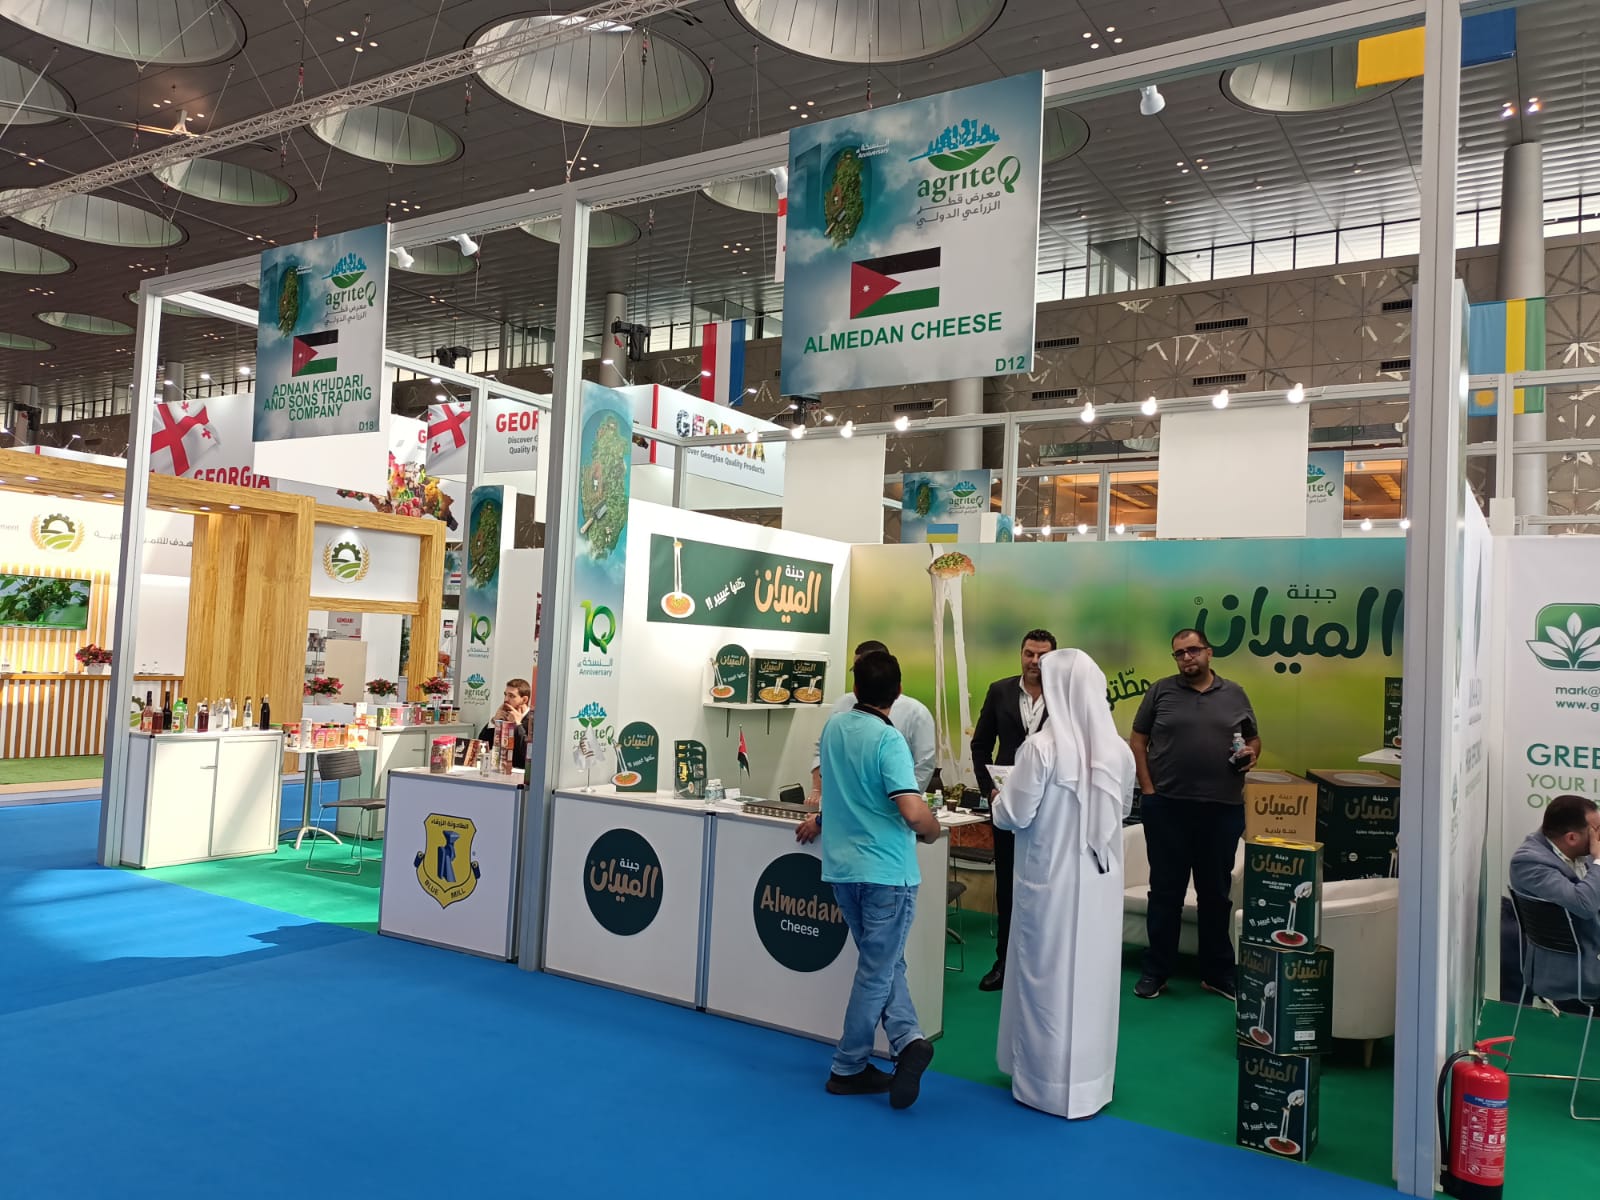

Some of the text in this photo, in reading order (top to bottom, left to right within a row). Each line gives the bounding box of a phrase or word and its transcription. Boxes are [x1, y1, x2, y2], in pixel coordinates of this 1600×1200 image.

[917, 156, 1021, 203] agriteQ
[965, 190, 1001, 205] معرض
[962, 200, 1001, 221] الزراعي
[325, 281, 377, 310] agriteQ
[804, 312, 1002, 354] ALMEDAN CHEESE
[995, 355, 1025, 372] D12
[272, 374, 363, 397] ADNAN KHUDARI
[264, 387, 372, 411] AND SONS TRADING
[289, 404, 342, 421] COMPANY
[496, 410, 539, 432] GEOR
[358, 421, 374, 431] D18
[417, 429, 427, 443] G
[507, 436, 533, 444] Discover
[509, 446, 531, 455] Quality
[687, 447, 766, 475] over Georgian Quality Products
[785, 565, 805, 582] جبنة
[754, 565, 822, 623] الميدان
[1286, 583, 1337, 604] جبنة
[1195, 586, 1404, 675] الميدان
[579, 668, 613, 678] Anniversary
[573, 725, 615, 745] agteQ
[1527, 773, 1585, 793] YOUR
[1255, 794, 1309, 820] الميدان
[1345, 795, 1400, 825] لميدان
[619, 858, 640, 873] جبنة
[1251, 853, 1305, 878] الميدان
[424, 879, 466, 899] BLUE MILL
[590, 858, 659, 903] الميدان
[760, 884, 843, 923] Almedan
[781, 919, 820, 937] Cheese
[1284, 959, 1328, 983] الميدان
[1245, 1057, 1298, 1083] الميدان
